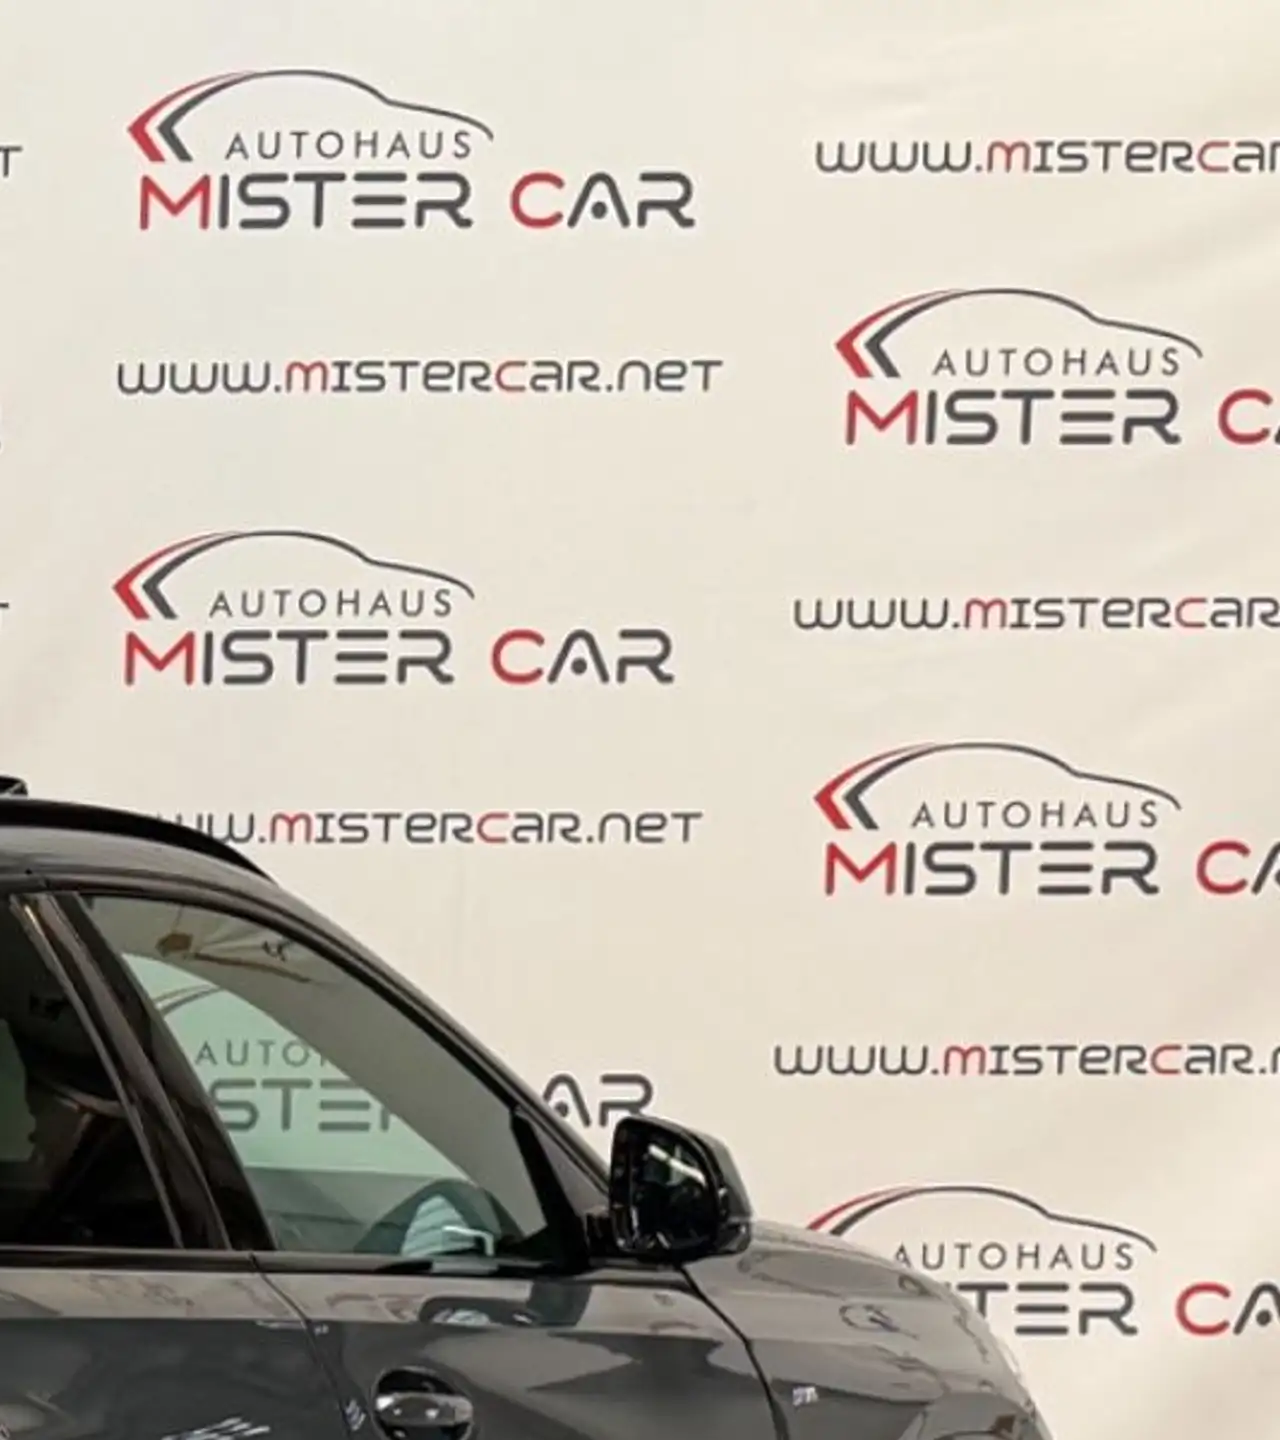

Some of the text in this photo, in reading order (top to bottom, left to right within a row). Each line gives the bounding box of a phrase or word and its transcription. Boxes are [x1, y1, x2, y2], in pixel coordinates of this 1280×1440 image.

[225, 131, 470, 160] AUTOHAUS
[140, 172, 694, 230] MISTER CAR
[933, 347, 1179, 376] AUTOHAUS
[846, 389, 1280, 445] MISTER C
[209, 589, 451, 617] AUTOHAUS
[125, 629, 673, 685] MISTER CAR
[911, 800, 1157, 829] AUTOHAUS
[825, 841, 1280, 895] MISTER C
[895, 1243, 1133, 1270] AUTOHAUS
